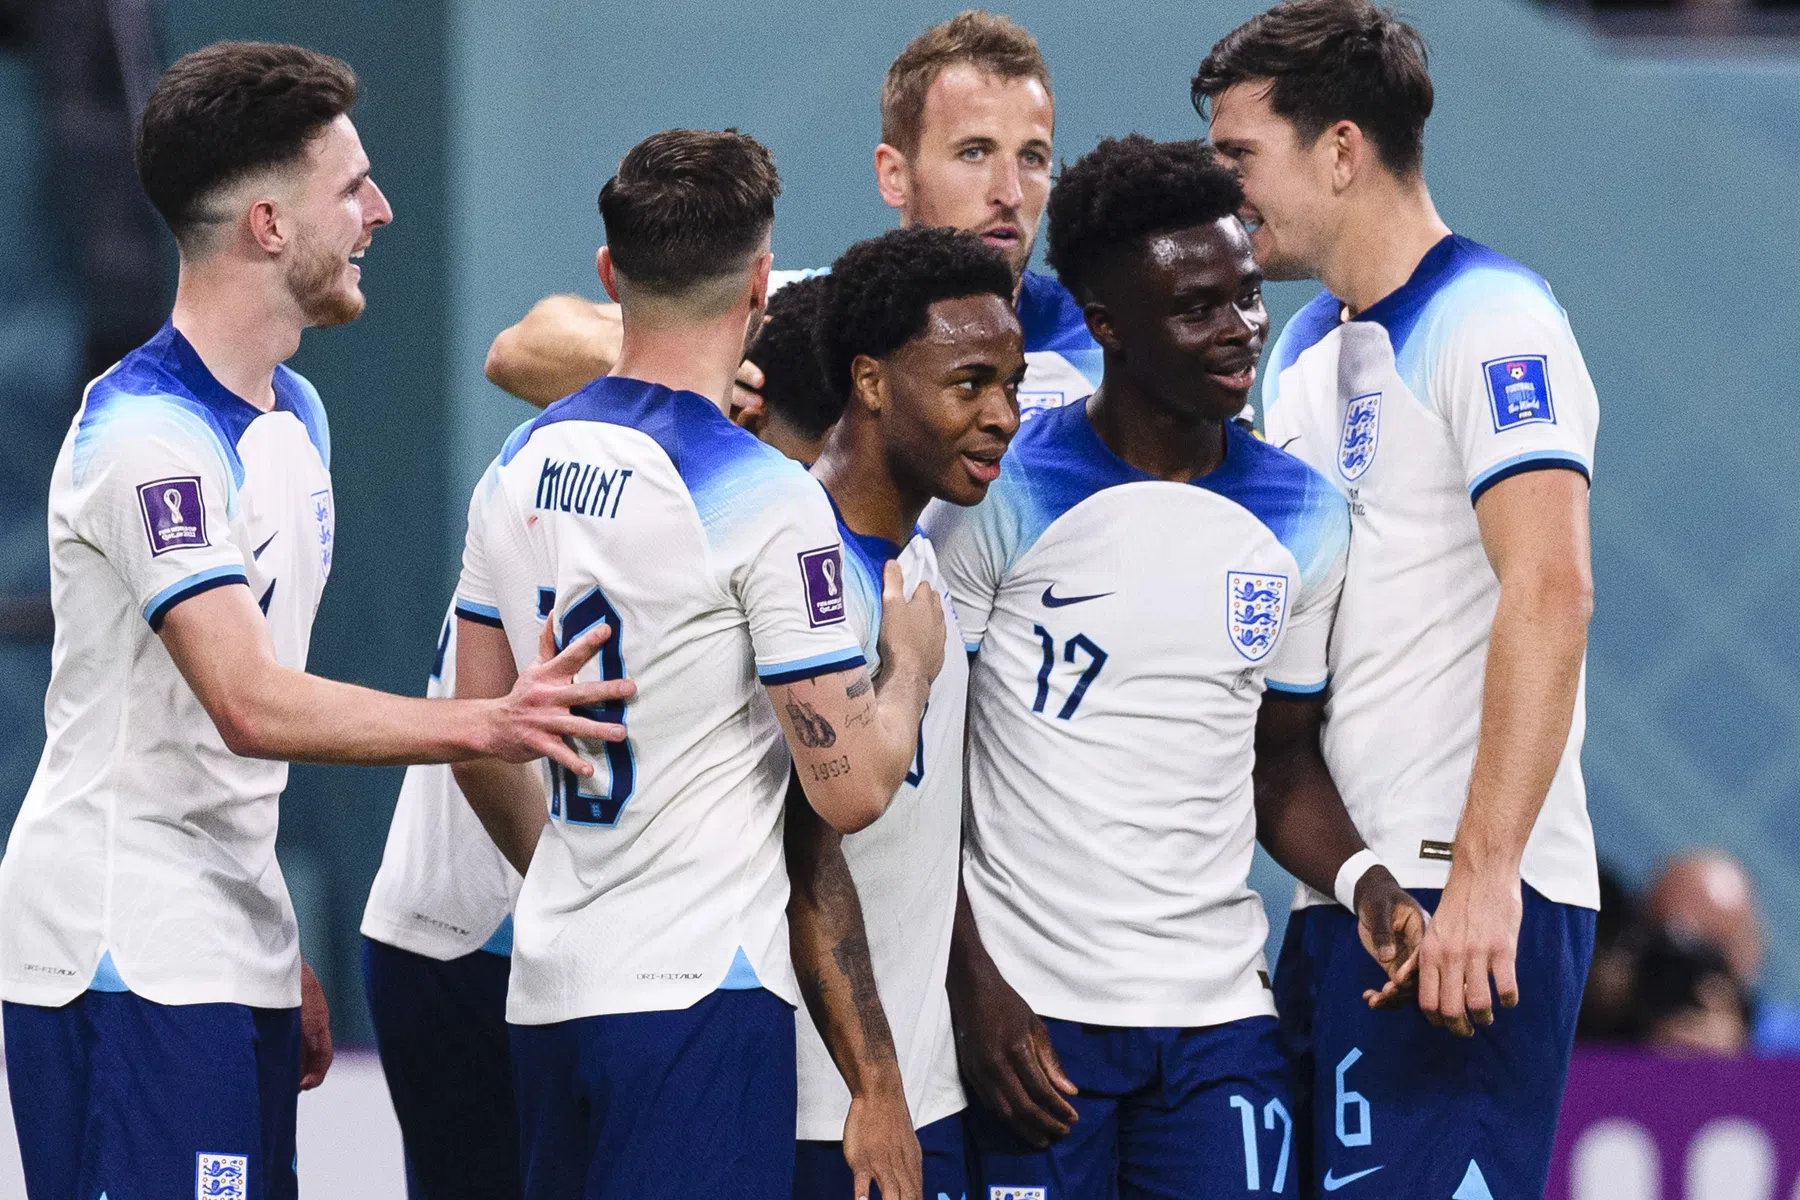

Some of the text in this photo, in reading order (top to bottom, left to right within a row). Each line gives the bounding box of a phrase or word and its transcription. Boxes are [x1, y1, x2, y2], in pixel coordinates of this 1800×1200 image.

[536, 457, 633, 519] MOUNT
[1032, 623, 1109, 720] 17
[811, 755, 851, 781] 1999
[1229, 1095, 1293, 1194] 17
[1336, 1047, 1372, 1147] 6
